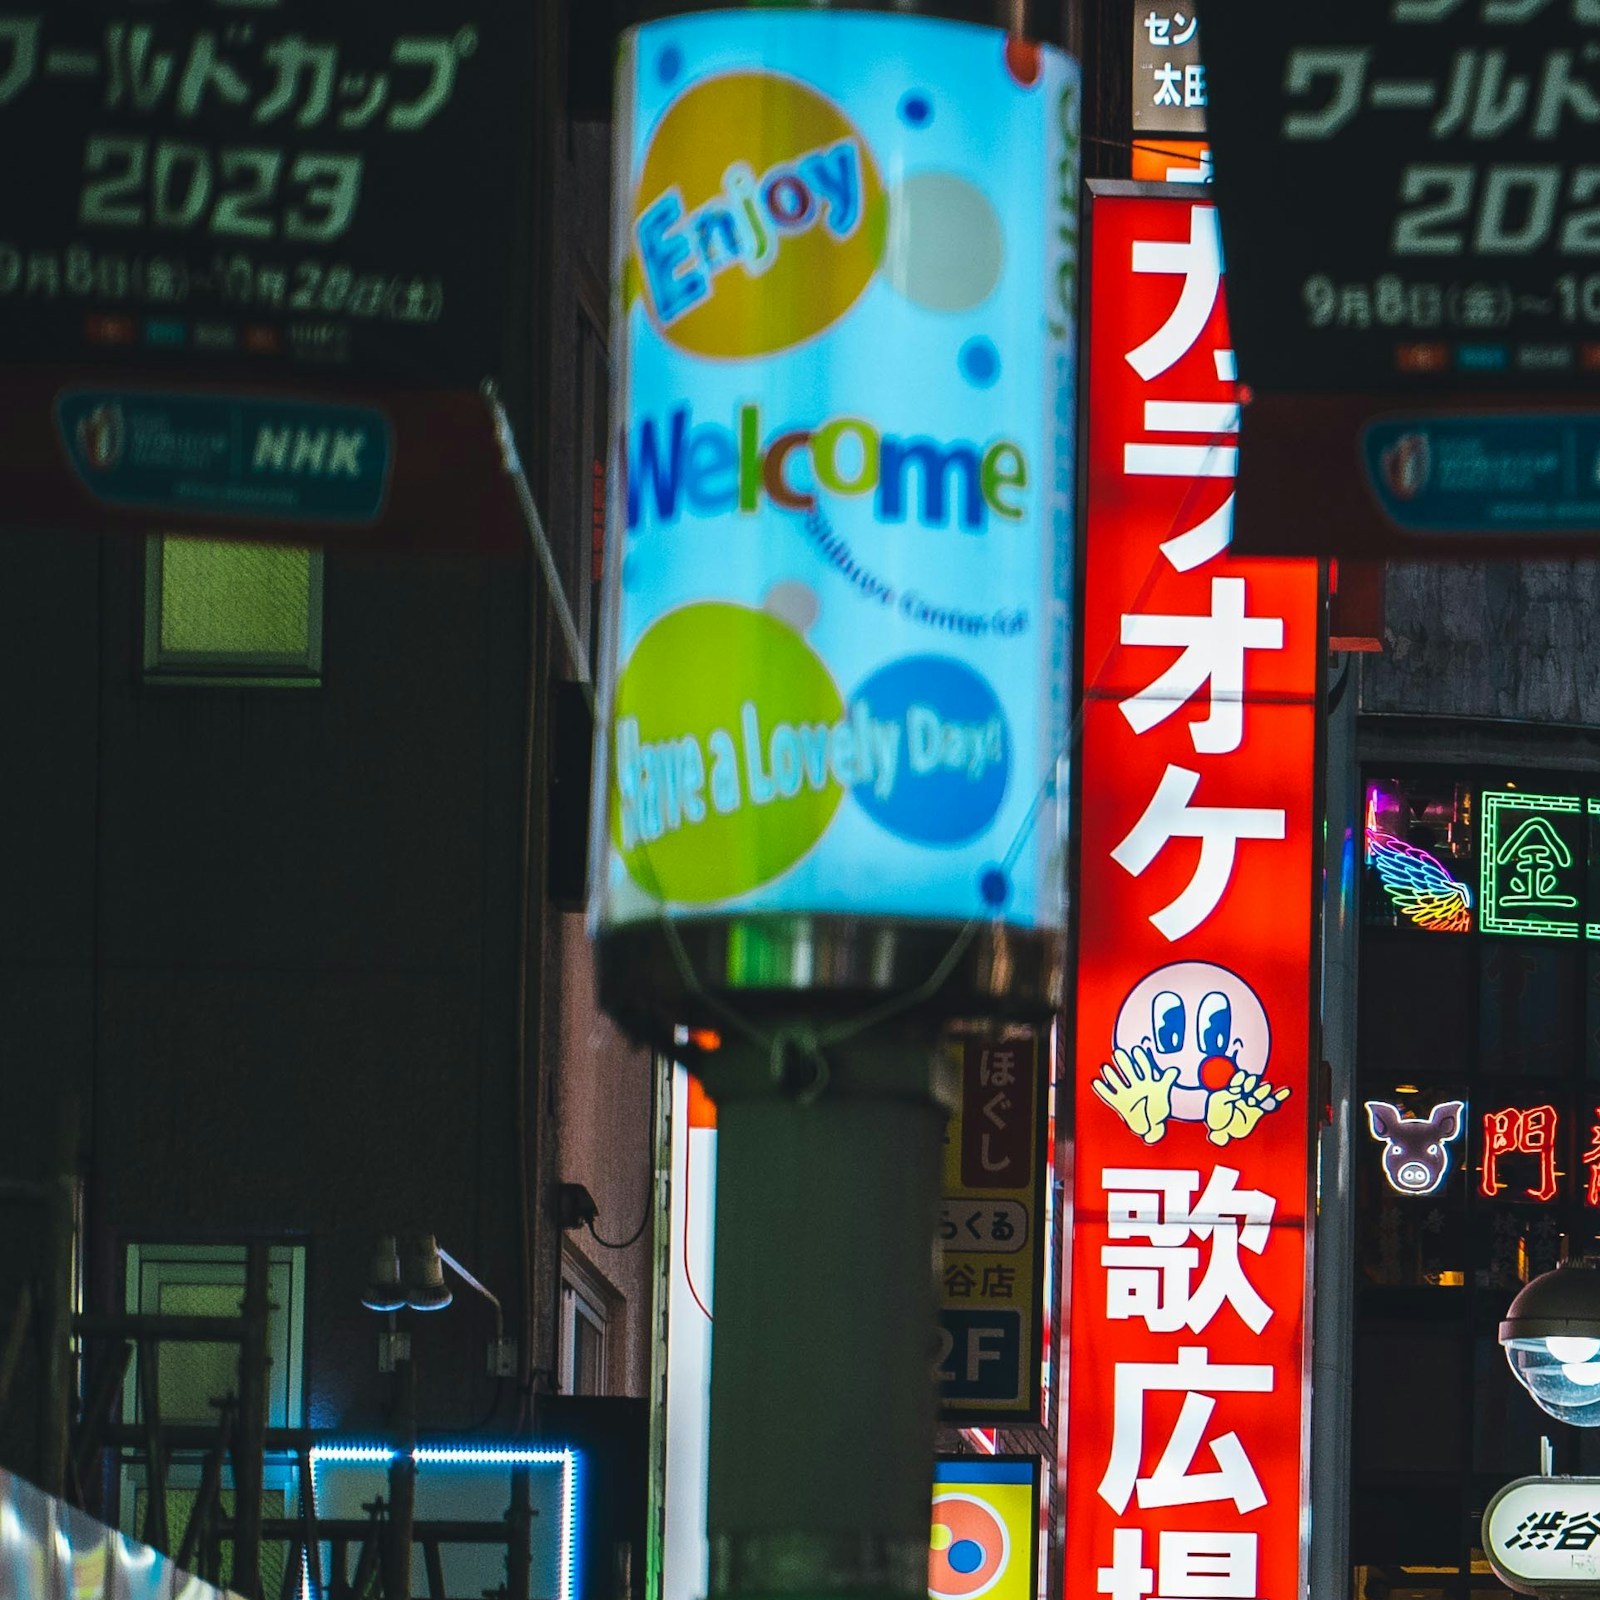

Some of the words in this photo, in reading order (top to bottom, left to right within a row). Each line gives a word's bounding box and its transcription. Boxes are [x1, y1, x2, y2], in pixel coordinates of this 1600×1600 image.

[80, 138, 363, 238] 2023
[634, 139, 863, 324] Enjoy
[253, 425, 366, 476] NHK
[624, 404, 1027, 532] Welcome
